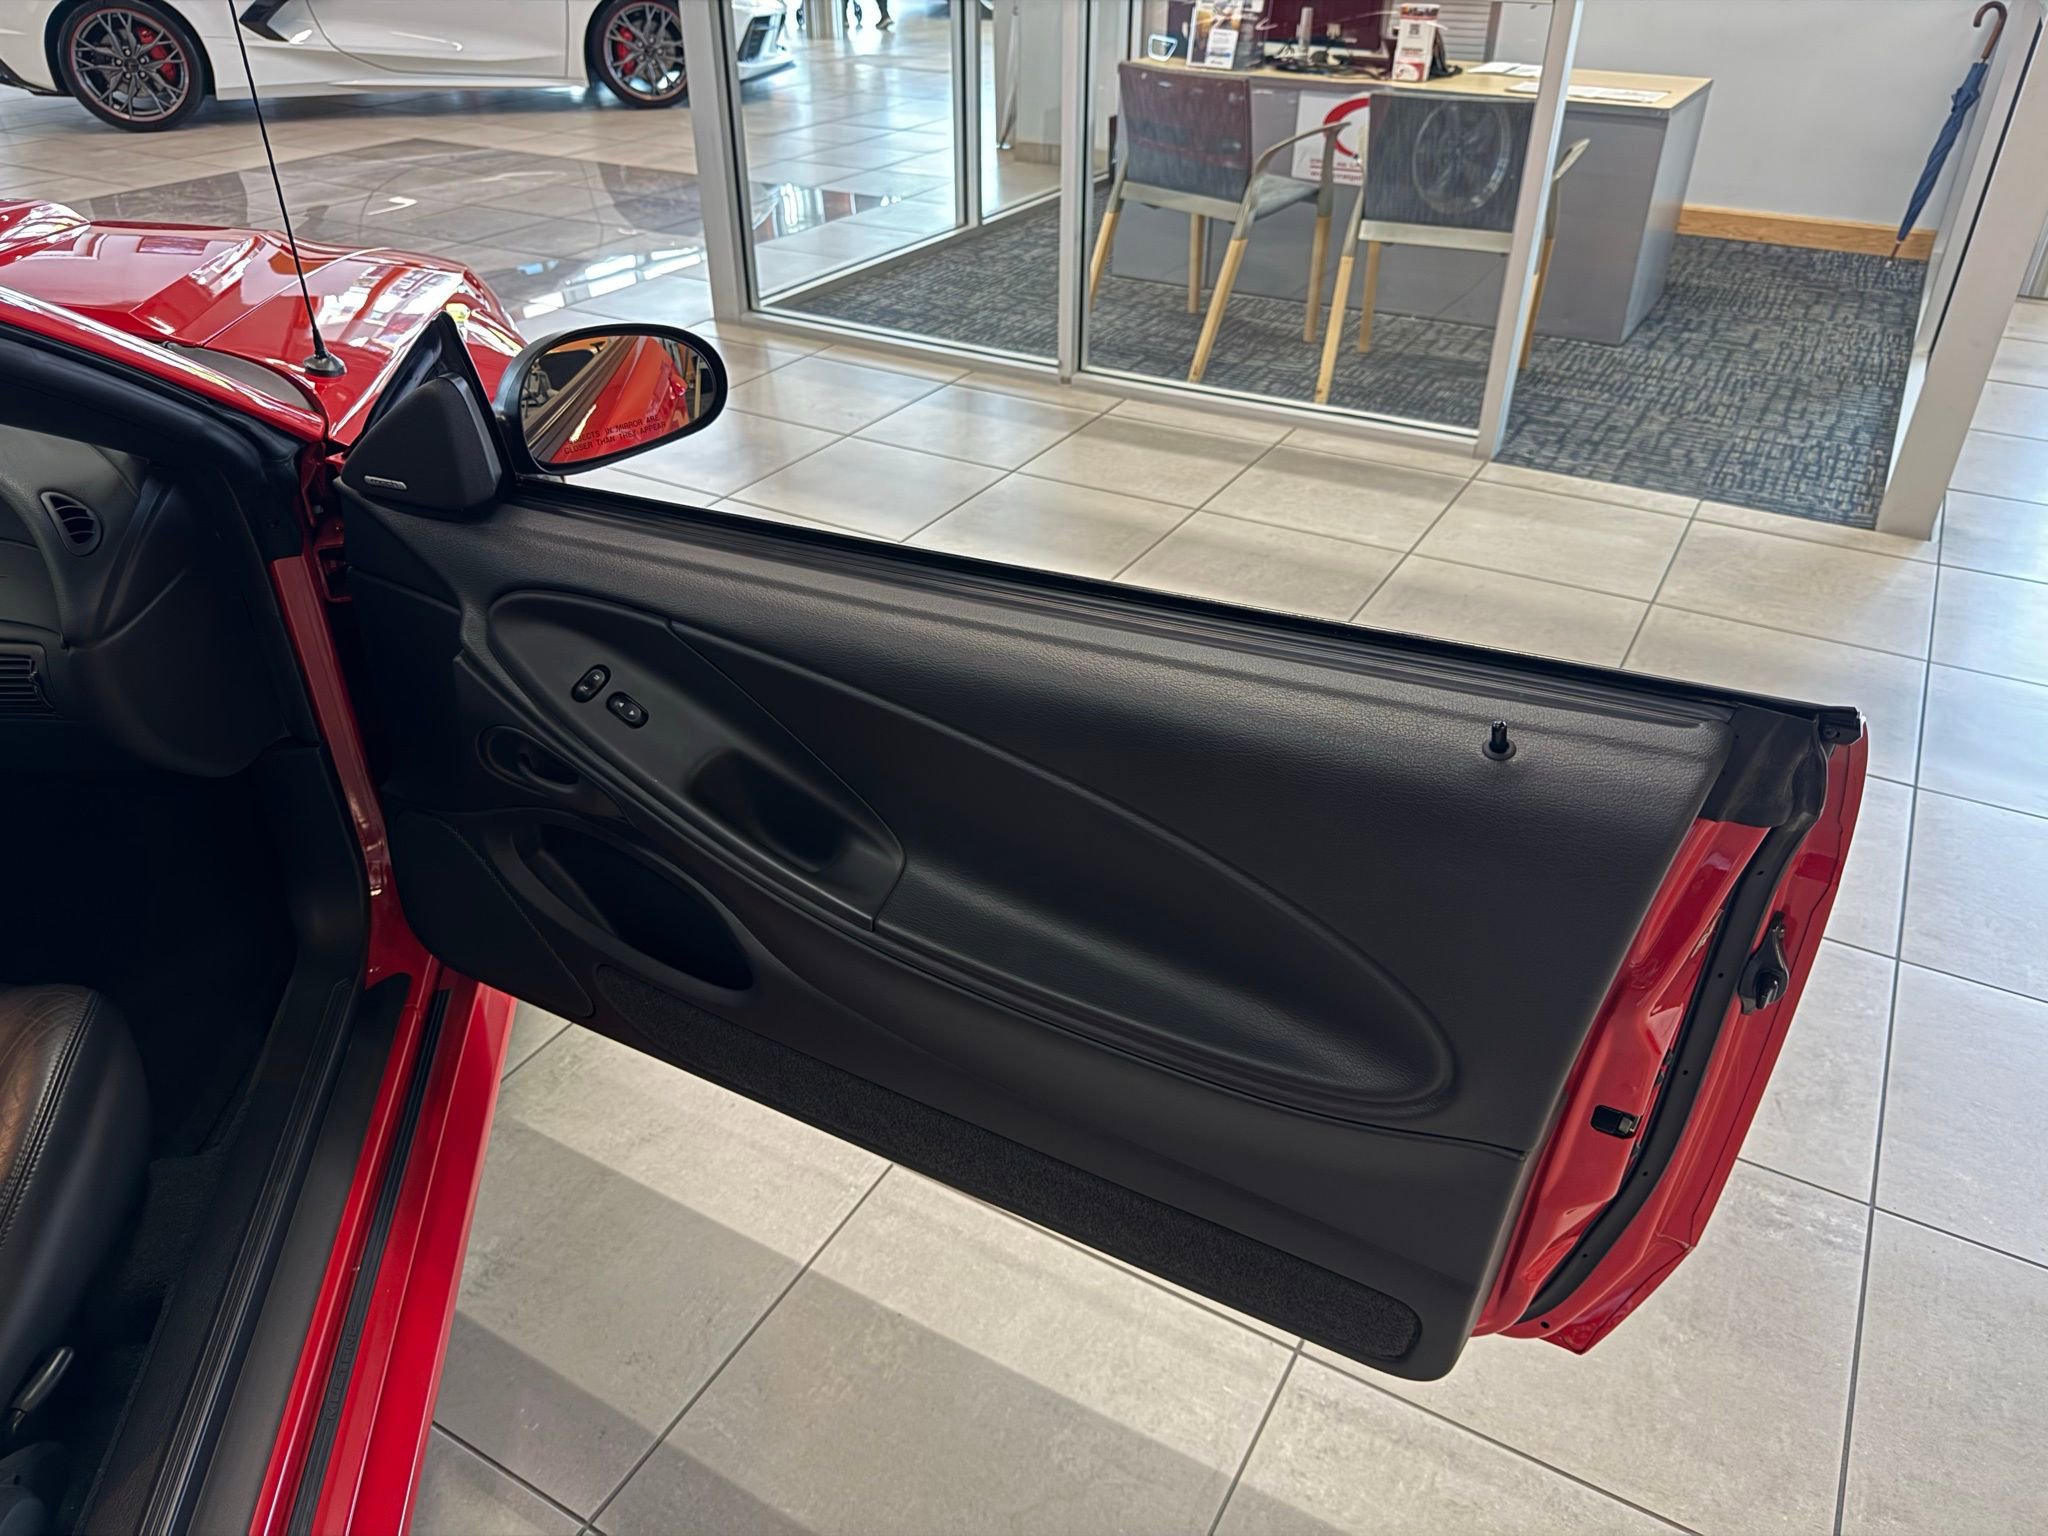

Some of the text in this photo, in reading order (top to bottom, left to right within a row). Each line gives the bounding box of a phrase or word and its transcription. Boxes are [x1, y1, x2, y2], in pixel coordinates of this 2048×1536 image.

[615, 419, 643, 431] MIRROR
[646, 414, 659, 423] ARE
[564, 421, 666, 454] CLOSER THAN THEY APPEAR
